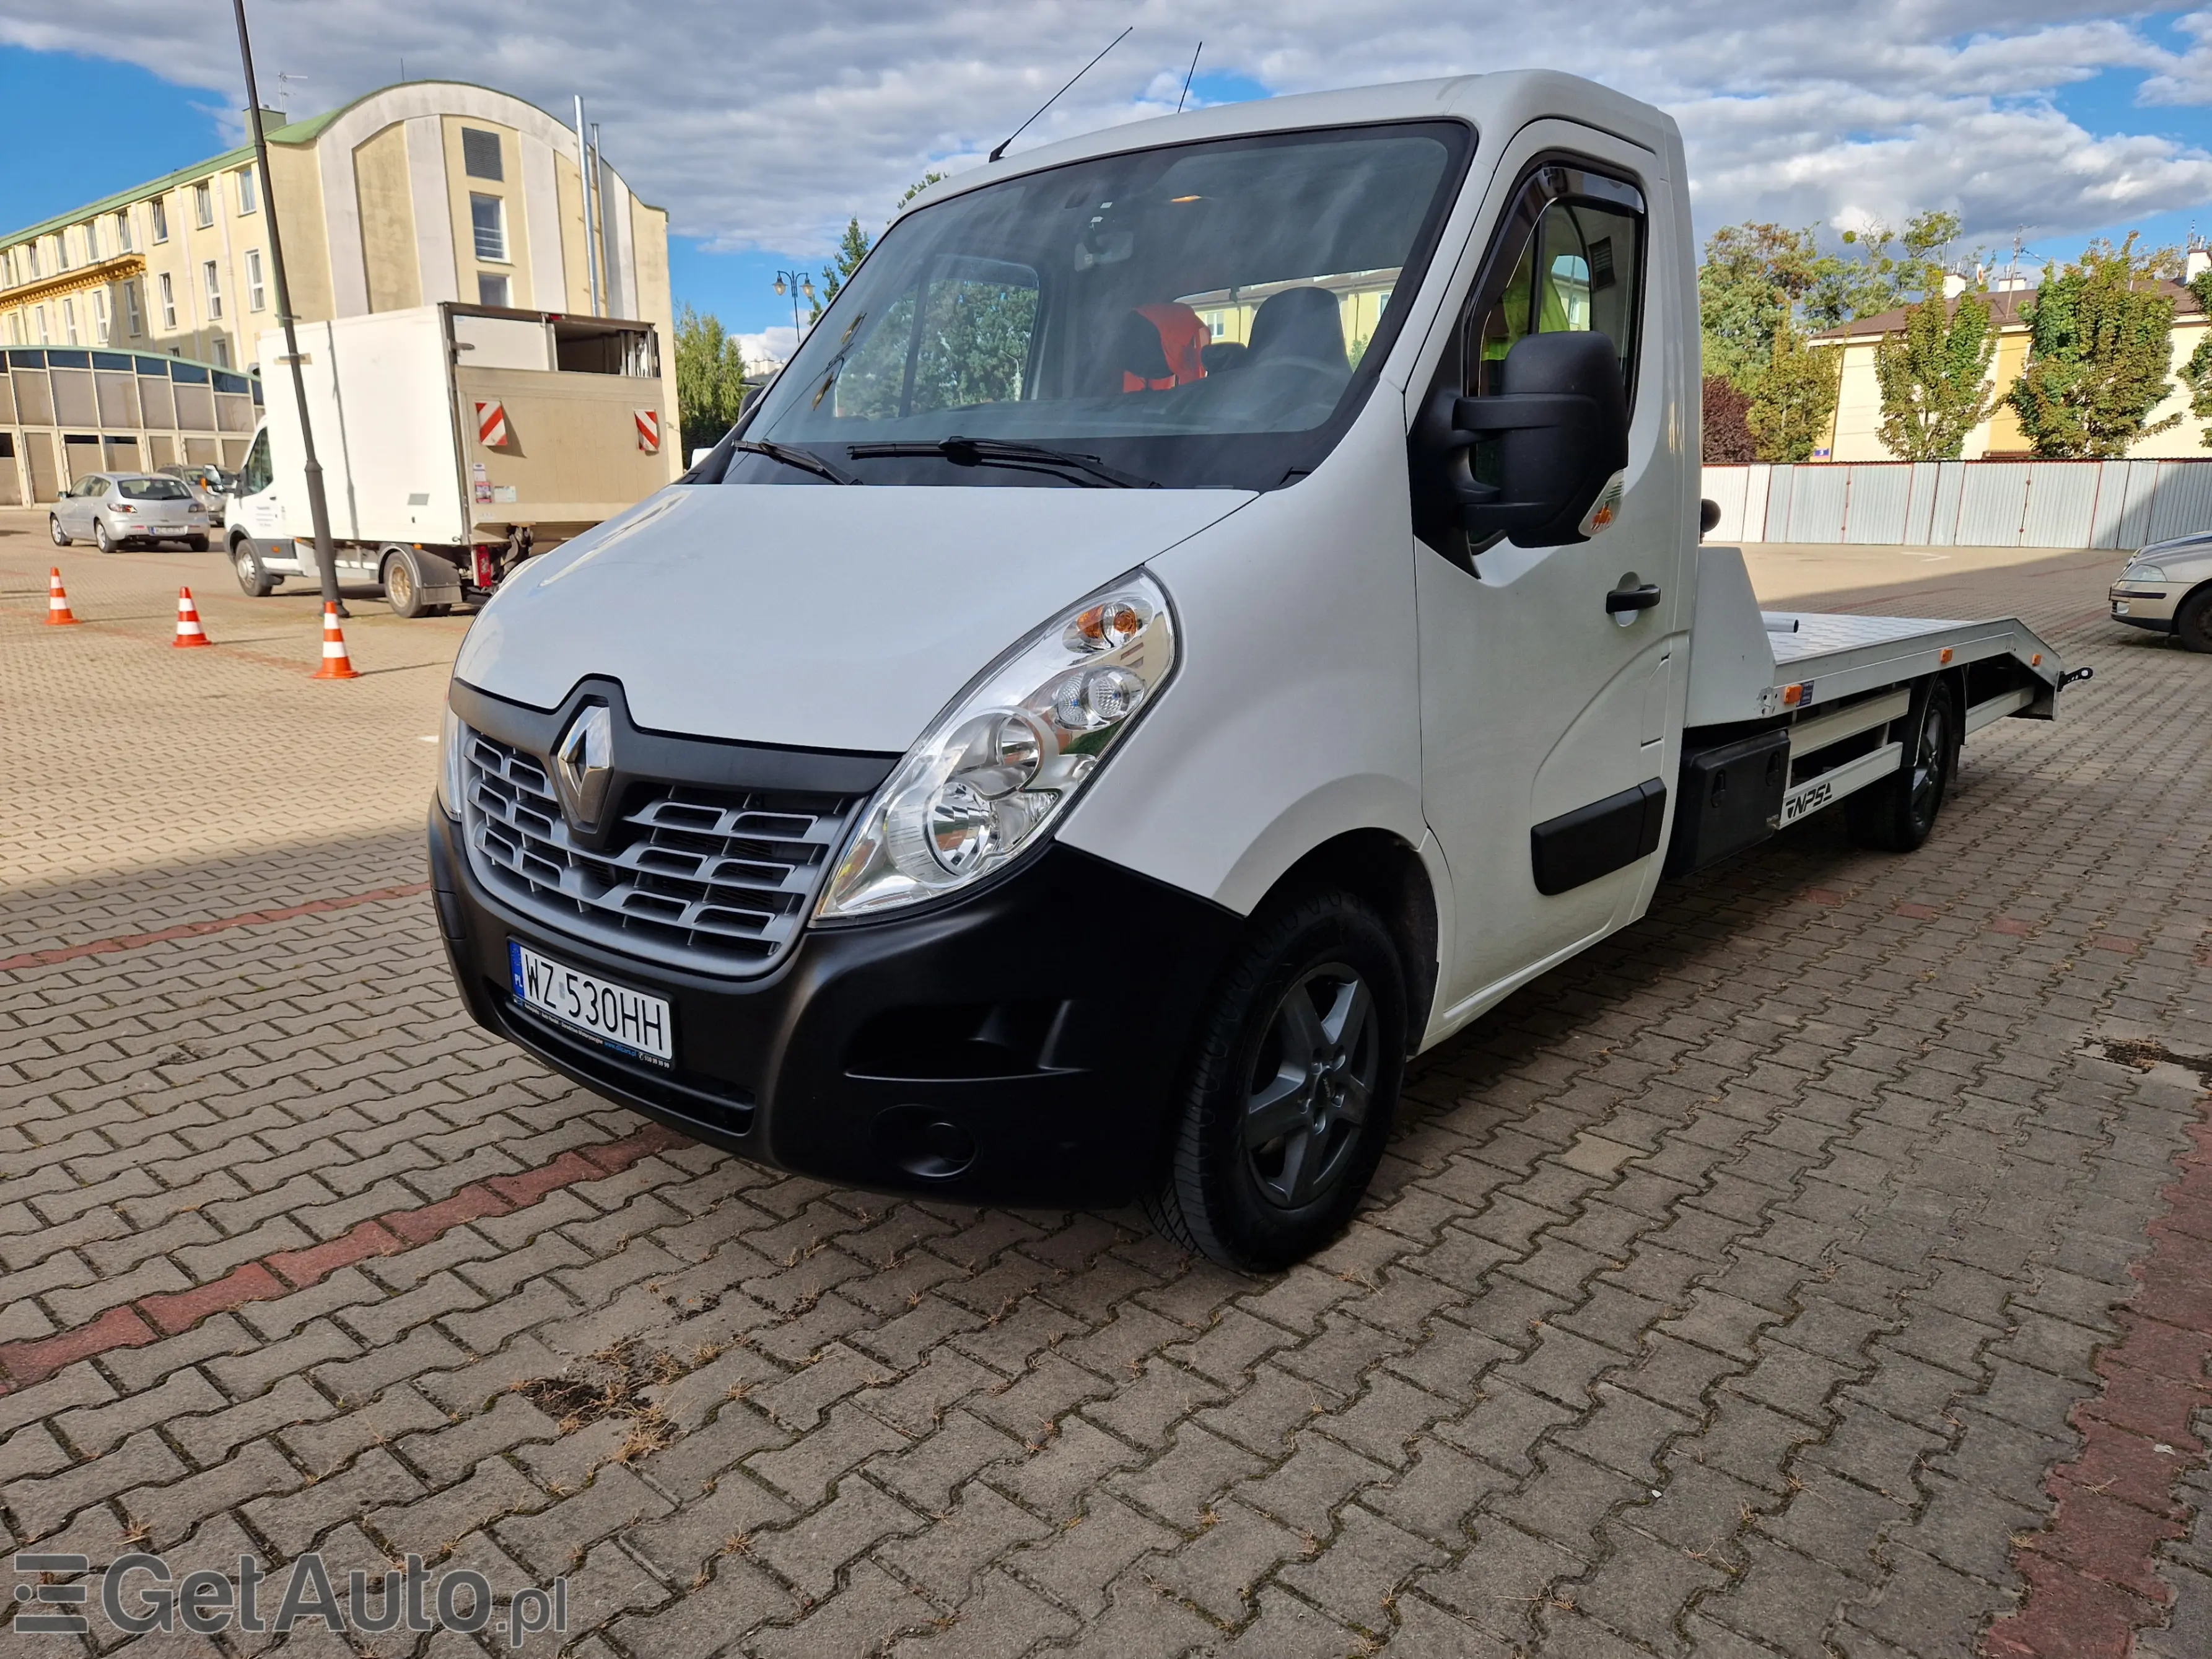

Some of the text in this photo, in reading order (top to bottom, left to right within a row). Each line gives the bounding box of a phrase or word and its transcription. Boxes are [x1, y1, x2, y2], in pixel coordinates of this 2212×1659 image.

[514, 973, 523, 987] PL
[525, 953, 556, 1009] WZ
[566, 971, 663, 1051] 530HH
